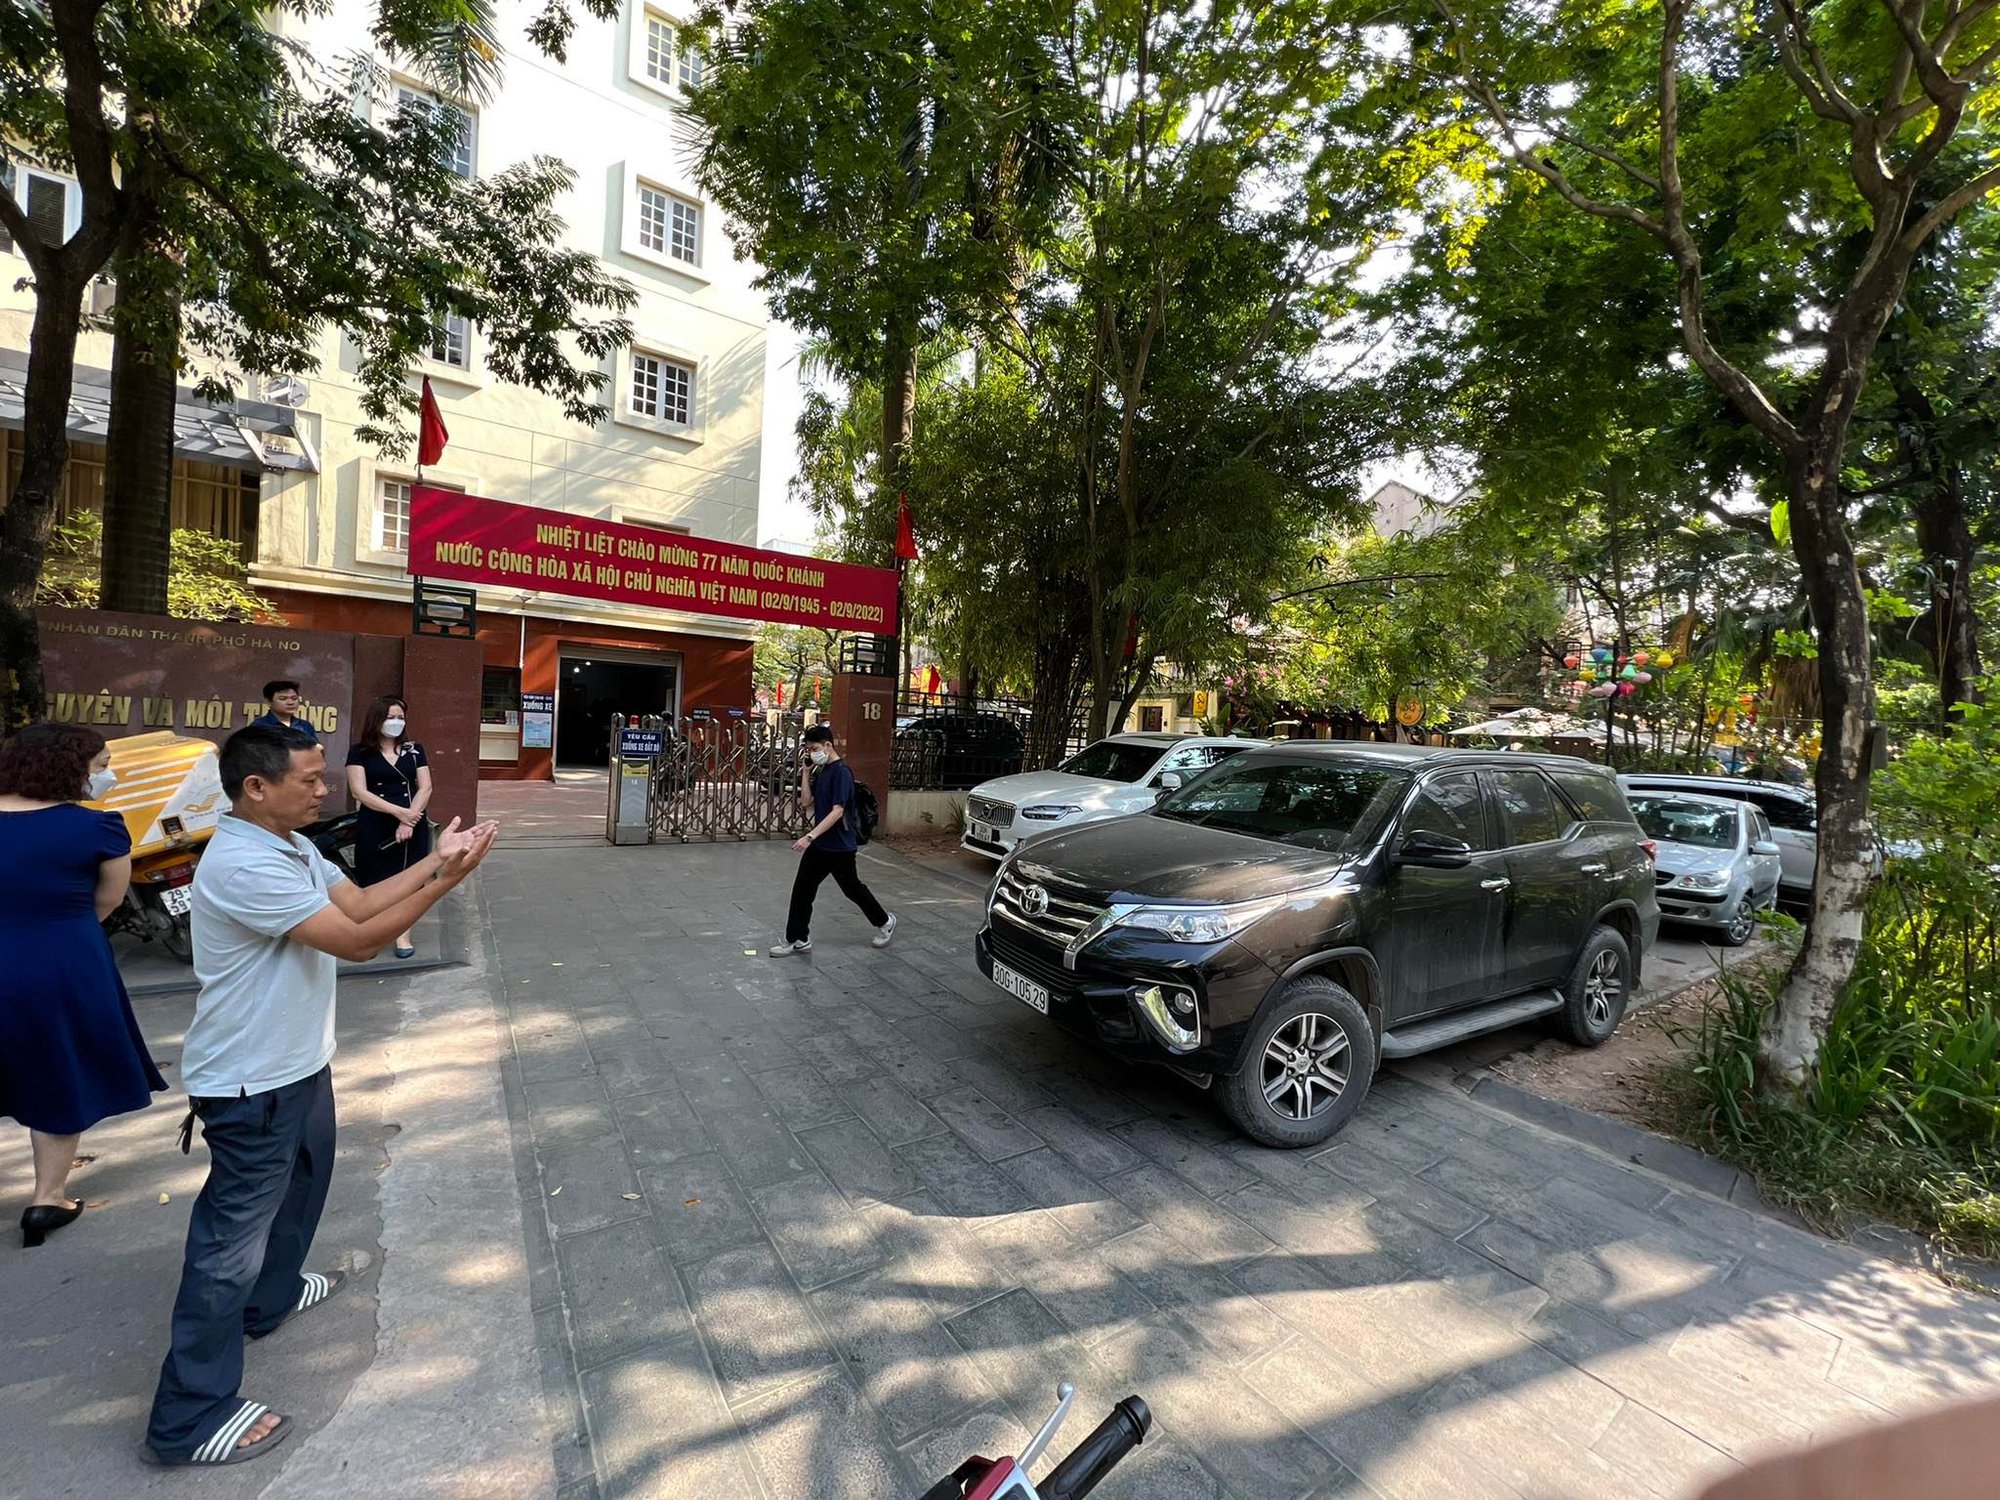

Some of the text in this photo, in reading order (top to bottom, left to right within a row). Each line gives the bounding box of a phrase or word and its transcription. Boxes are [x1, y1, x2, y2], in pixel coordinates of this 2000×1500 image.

[536, 523, 825, 588] NHIỆT LIỆT CHÀO MỪNG 77 NĂM QUỐC KHÁNH
[435, 541, 483, 567] NƯỚC
[487, 548, 533, 575] CỘNG
[537, 554, 568, 580] HÒA
[572, 561, 592, 584] XÃ
[596, 564, 620, 590] HỘI
[624, 568, 651, 593] CHỦ
[655, 574, 697, 598] NGHĨA
[700, 580, 726, 604] VIỆT
[729, 586, 758, 607] NAM
[760, 591, 820, 615] (02/9/1945
[830, 600, 884, 623] 02/9/2022)
[185, 694, 233, 729] MÔI
[862, 702, 881, 720] 18
[994, 964, 1046, 1010] 30G-105.29
